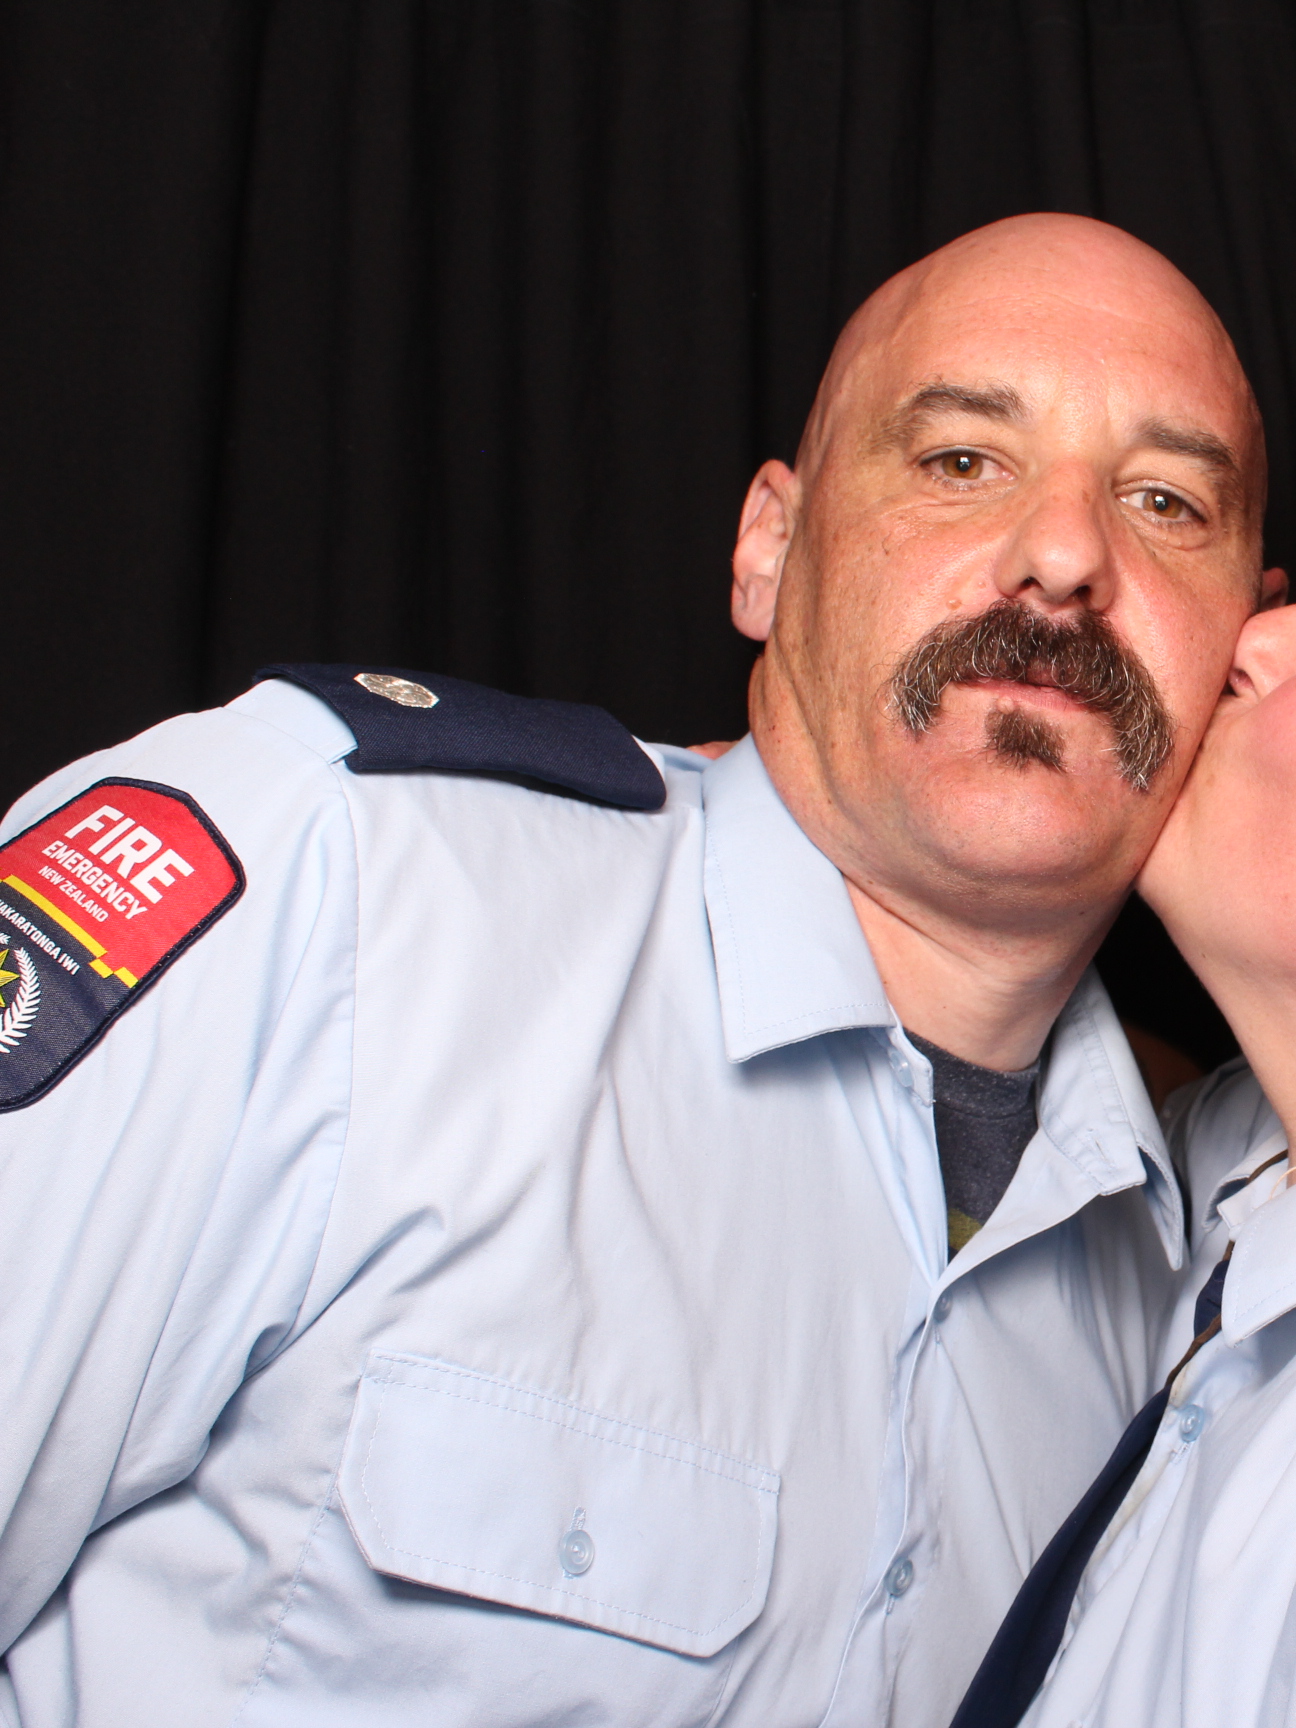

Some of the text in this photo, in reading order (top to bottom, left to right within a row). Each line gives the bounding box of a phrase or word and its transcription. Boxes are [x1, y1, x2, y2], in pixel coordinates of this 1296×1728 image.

[41, 840, 148, 919] EMERGENCY
[64, 805, 195, 904] FIRE
[38, 866, 109, 922] NEW ZEALAND
[0, 899, 80, 975] AKARATONGA IWI
